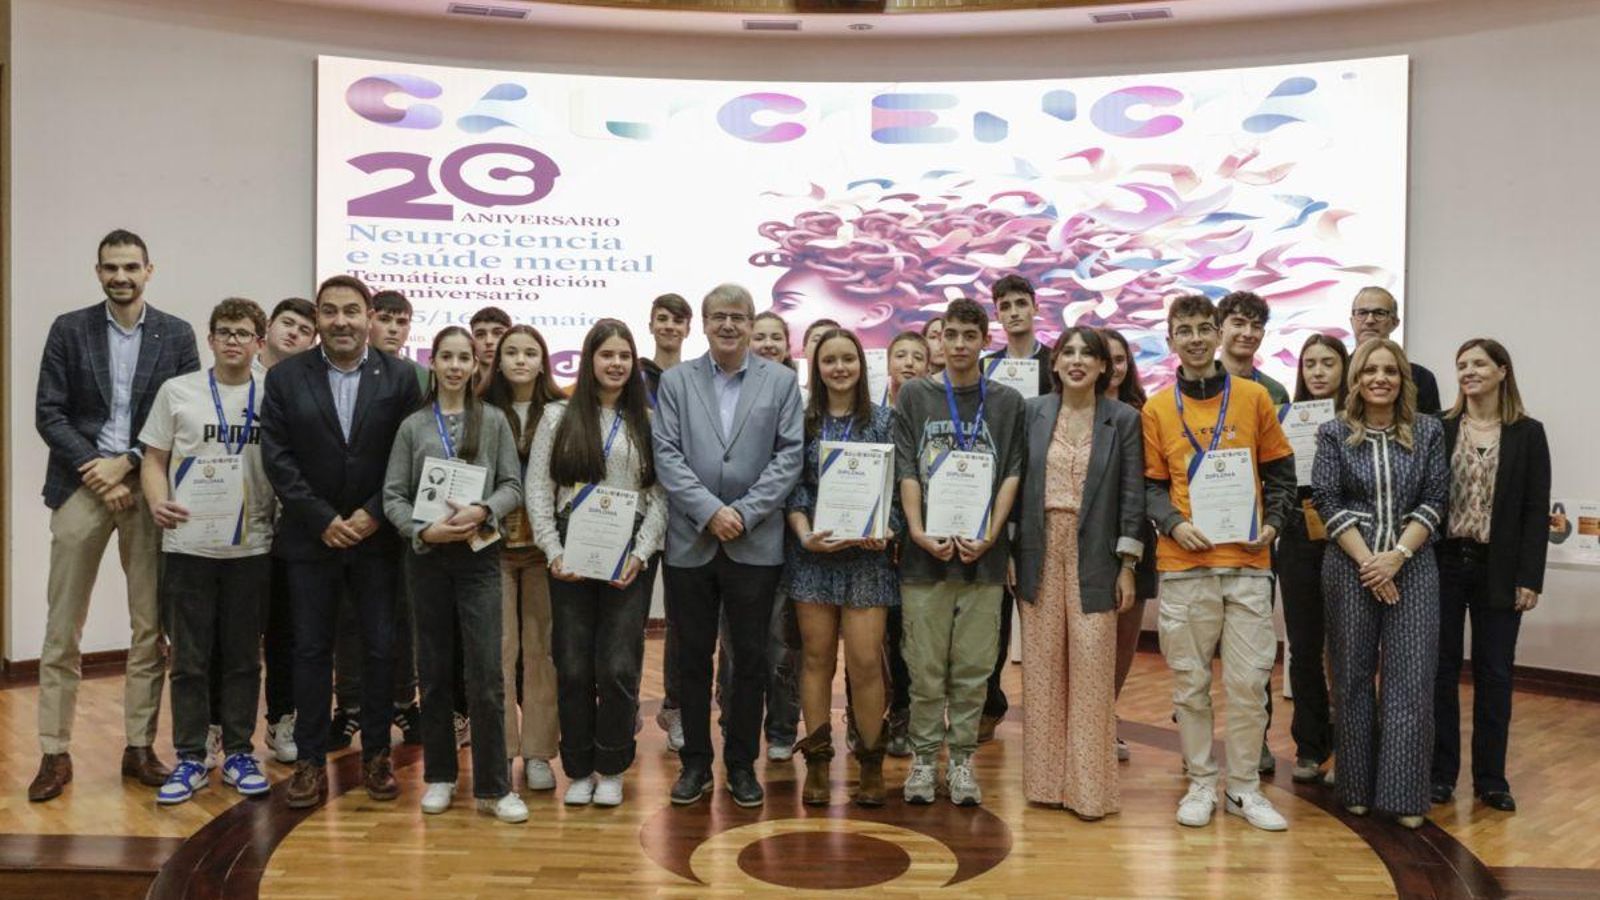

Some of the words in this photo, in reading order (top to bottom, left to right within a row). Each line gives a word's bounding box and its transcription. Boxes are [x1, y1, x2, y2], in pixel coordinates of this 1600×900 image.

[461, 211, 622, 228] ANIVERSARIO
[346, 223, 625, 251] Neurociencia
[346, 249, 372, 266] e
[381, 249, 502, 269] saúde
[514, 254, 654, 273] mental
[346, 269, 468, 286] Temática
[475, 273, 506, 287] da
[519, 274, 608, 289] edición
[203, 424, 261, 445] PUMA
